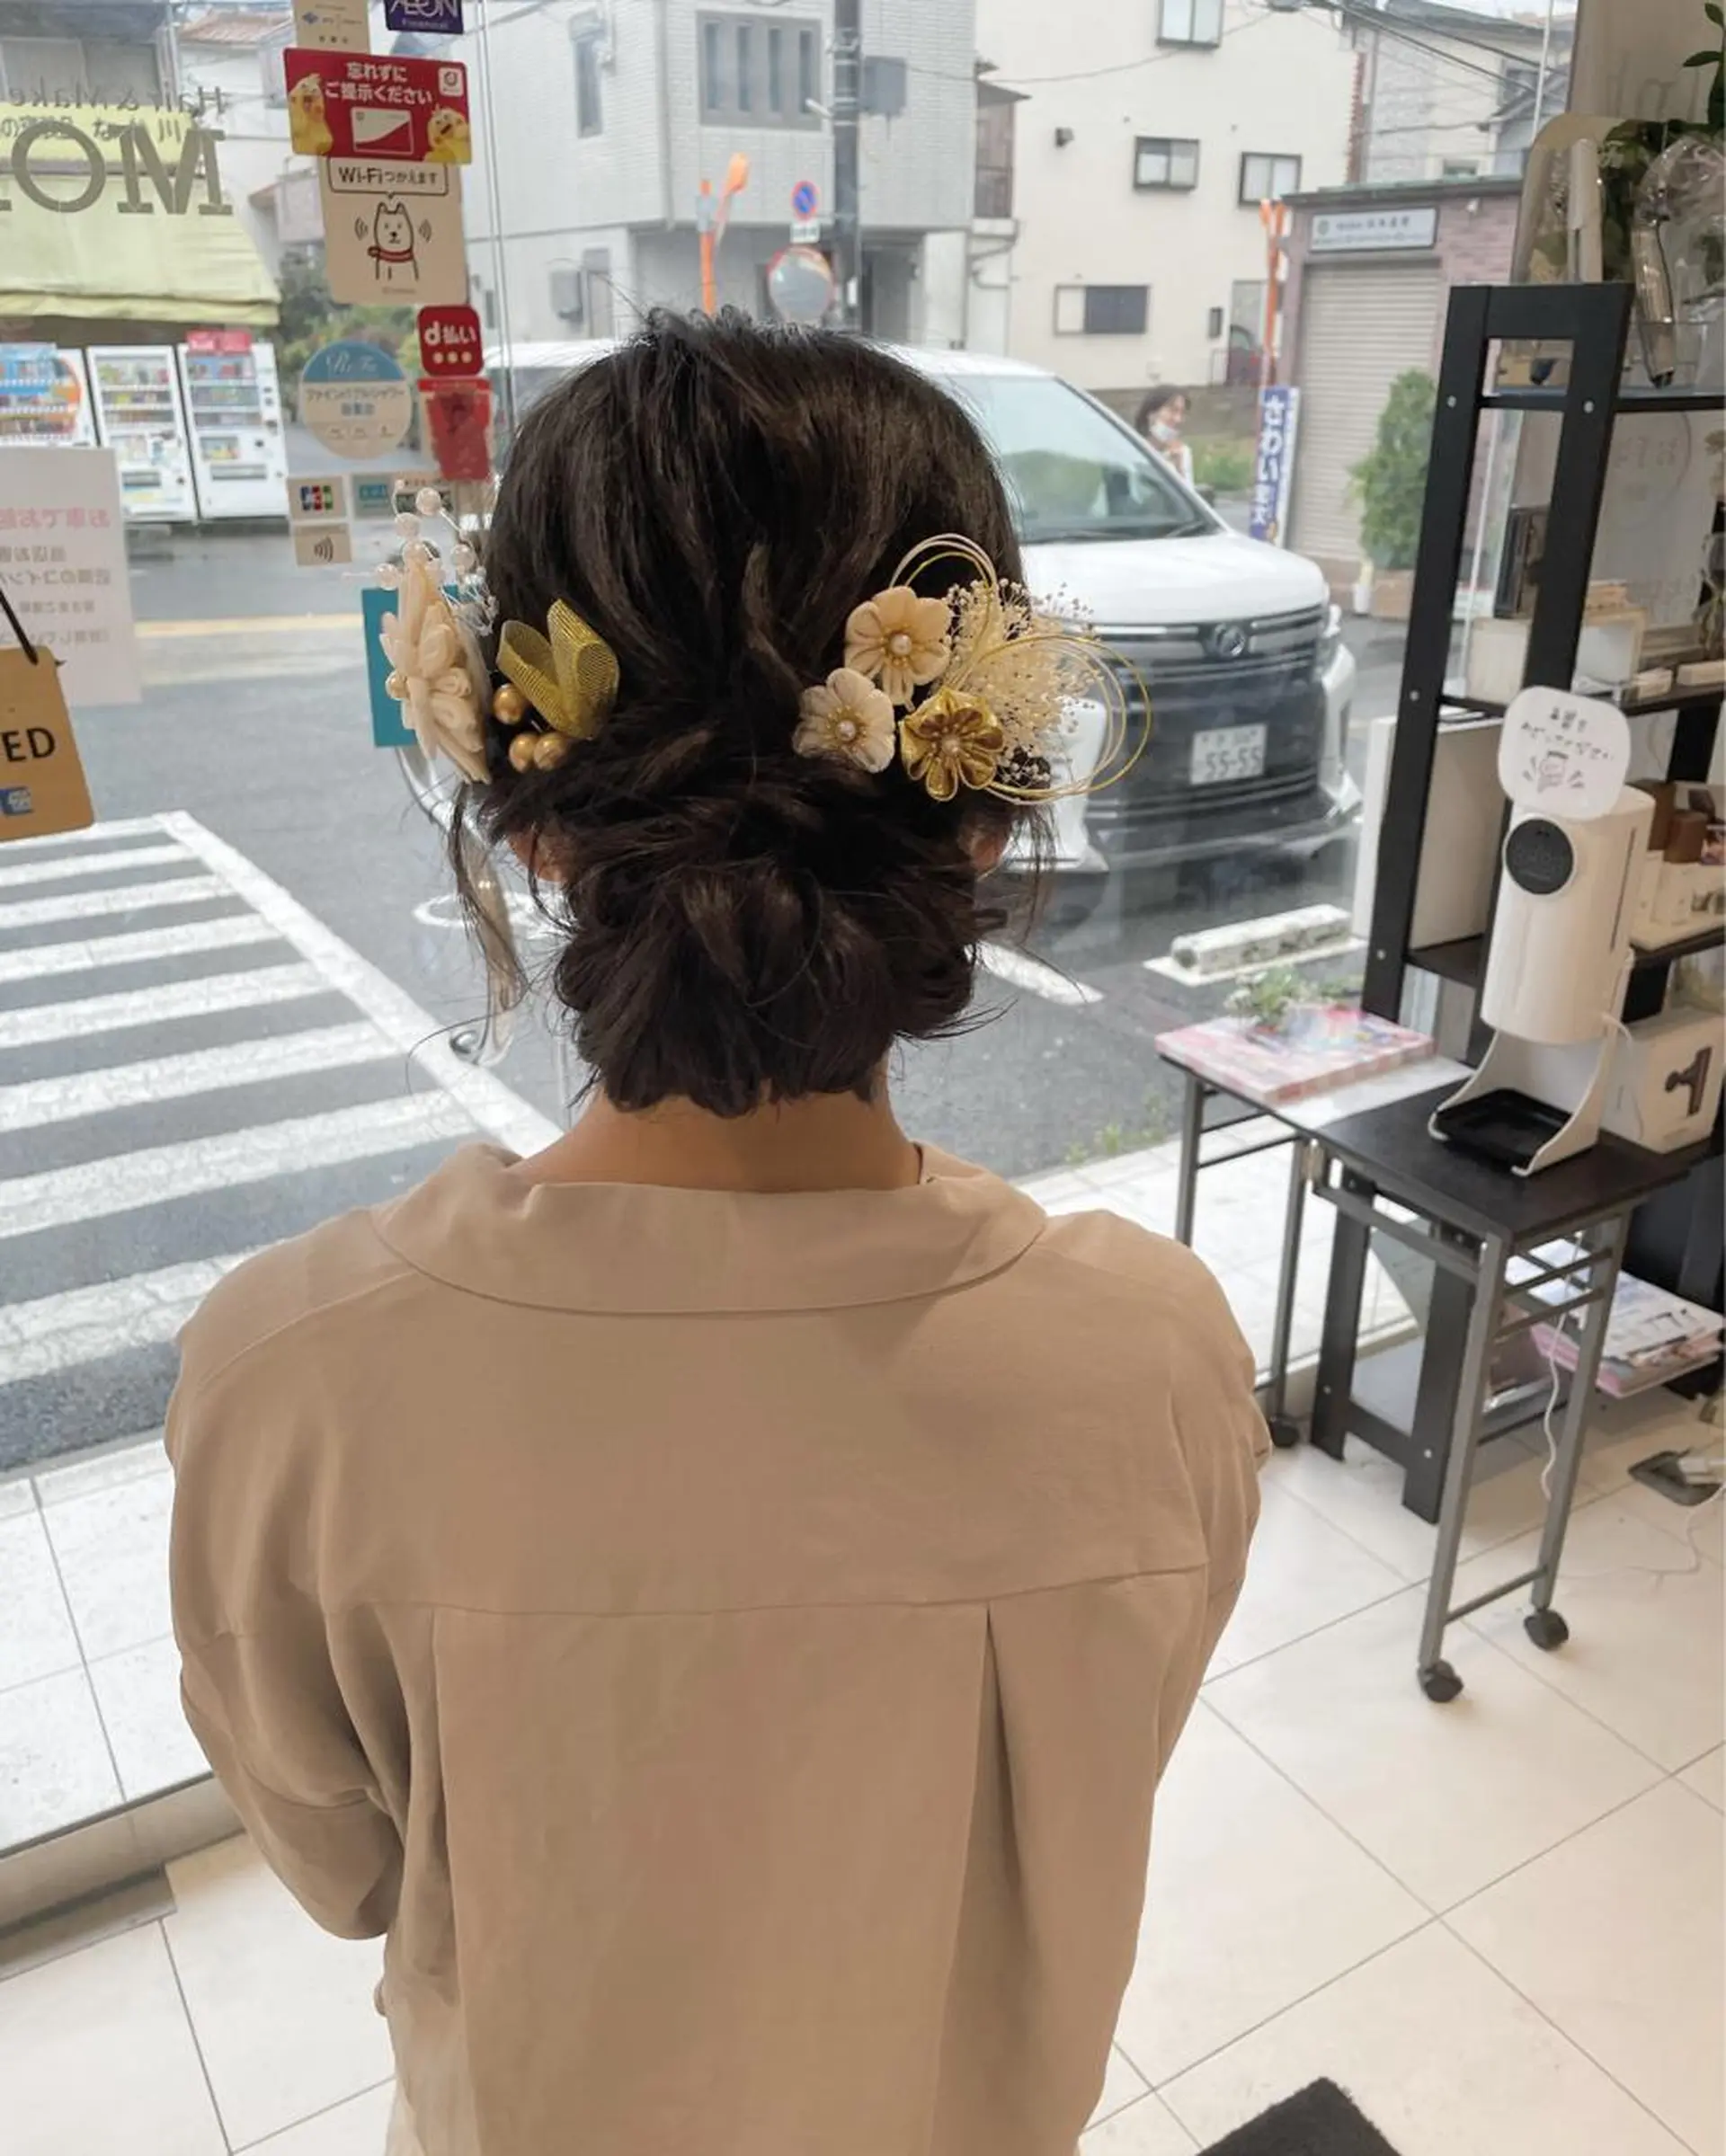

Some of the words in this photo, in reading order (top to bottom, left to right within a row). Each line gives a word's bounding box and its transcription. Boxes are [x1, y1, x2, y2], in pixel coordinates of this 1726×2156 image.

[345, 61, 408, 84] 忘れずに
[325, 81, 433, 104] ご提示ください
[424, 321, 476, 346] d払い
[300, 484, 334, 511] JCB
[0, 726, 56, 763] ED
